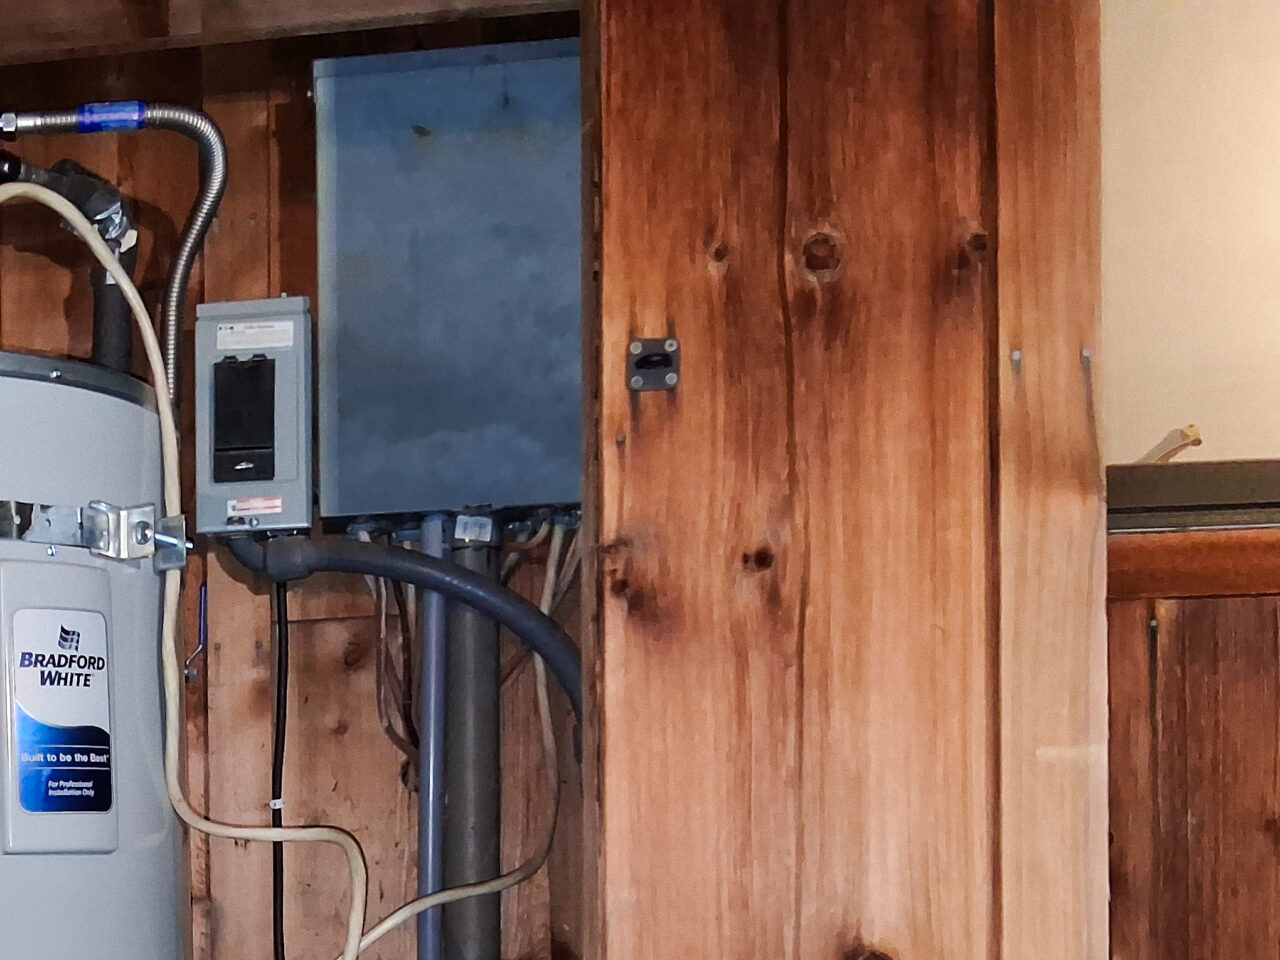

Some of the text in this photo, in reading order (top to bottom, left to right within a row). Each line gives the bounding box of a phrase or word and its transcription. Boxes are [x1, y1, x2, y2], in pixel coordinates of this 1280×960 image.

[20, 652, 105, 671] BRADFORD
[39, 670, 91, 688] WHITE
[46, 753, 57, 762] to
[59, 753, 72, 763] be
[74, 753, 88, 763] the
